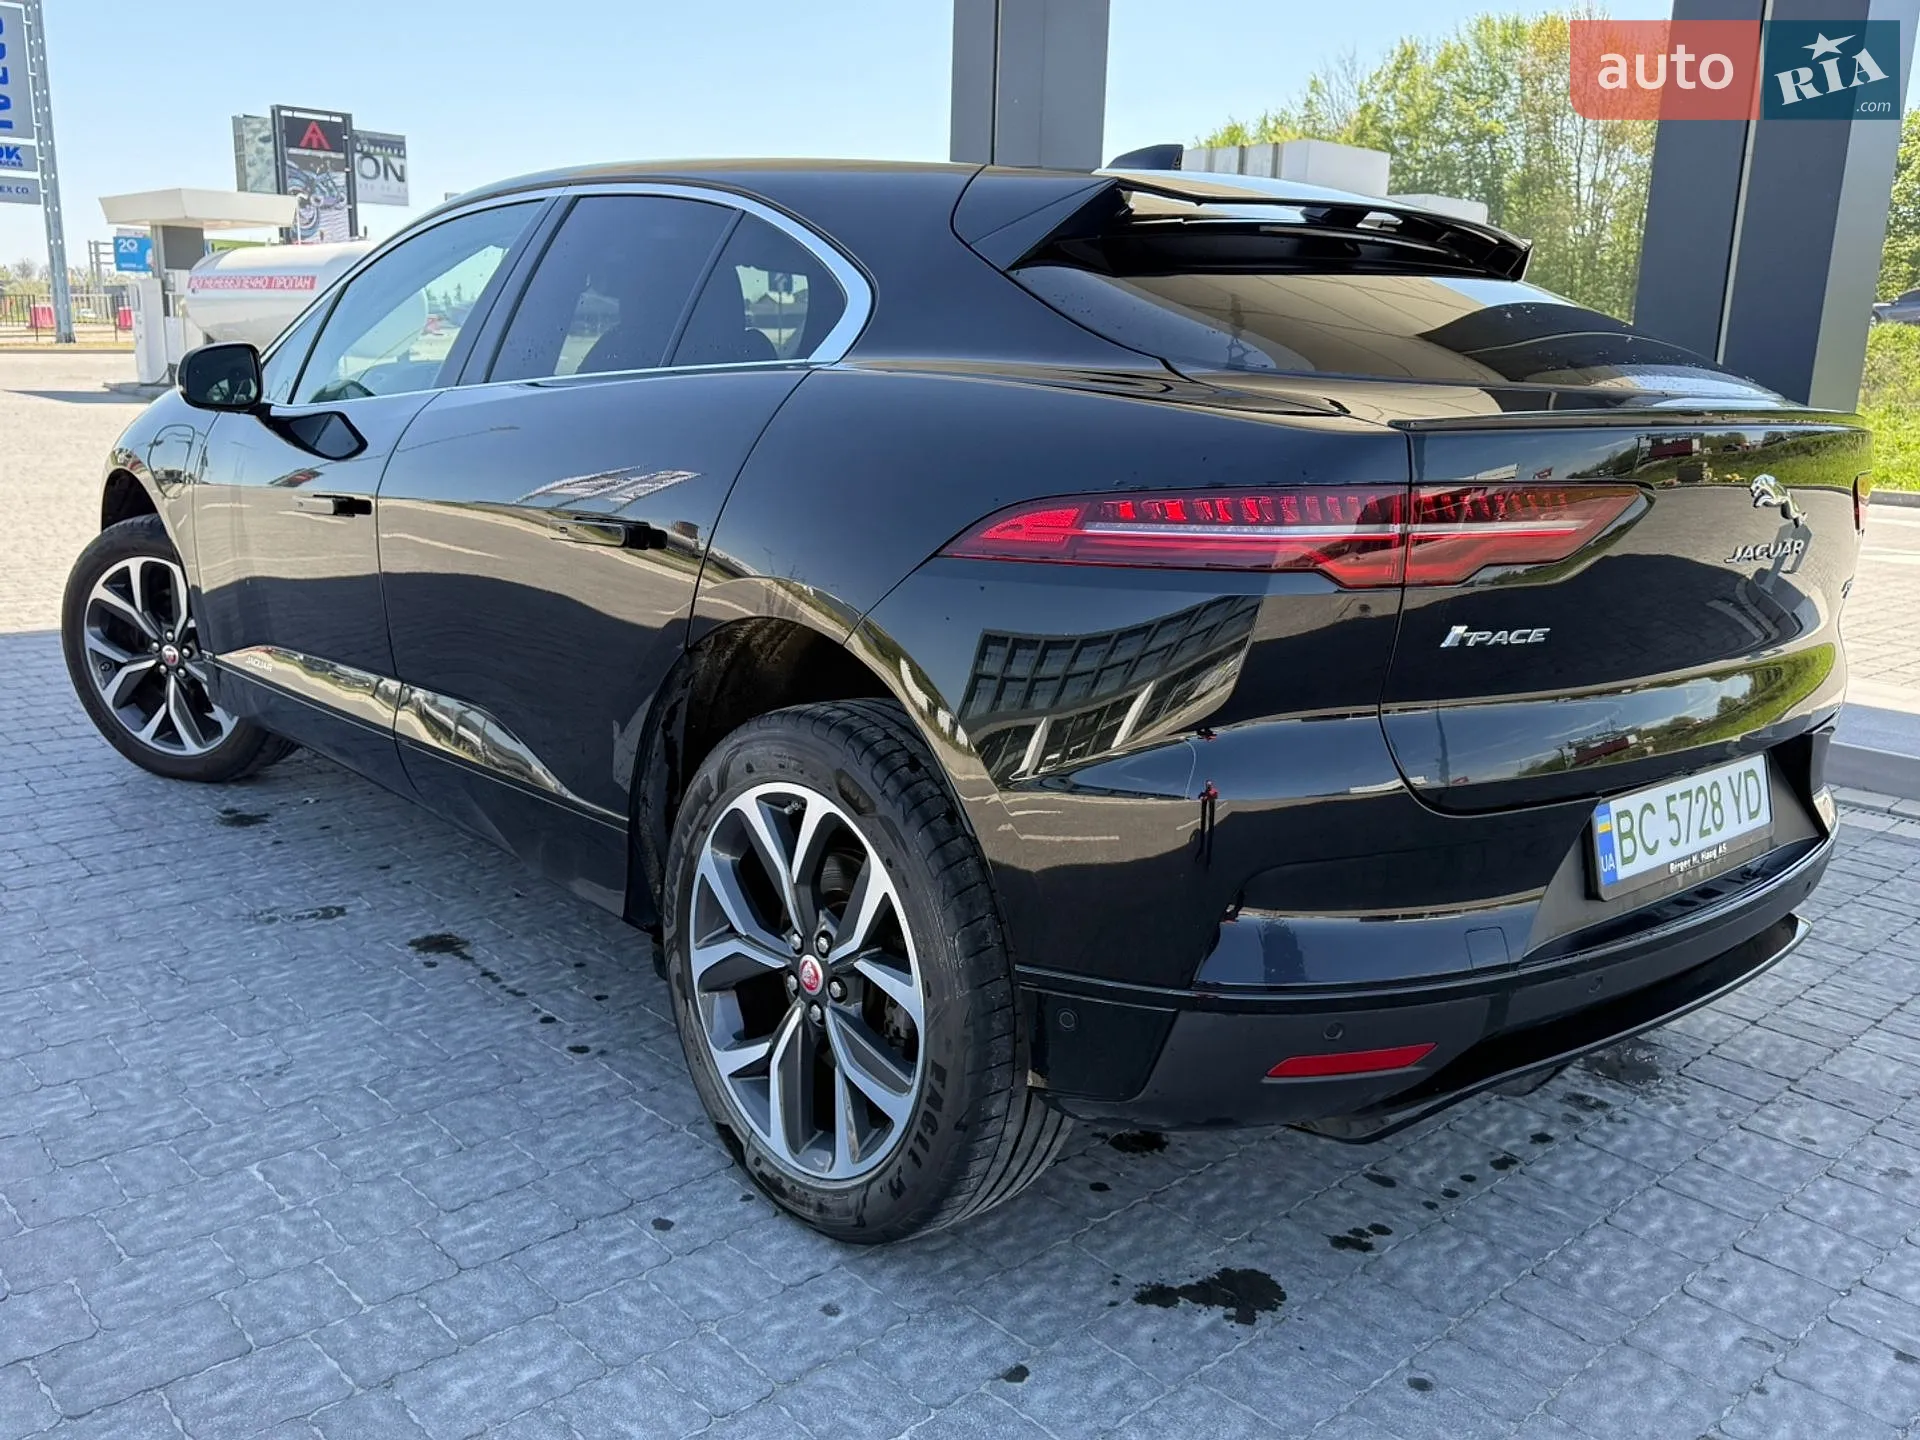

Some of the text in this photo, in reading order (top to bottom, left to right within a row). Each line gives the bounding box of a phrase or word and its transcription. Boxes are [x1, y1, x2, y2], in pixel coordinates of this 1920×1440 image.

[271, 275, 313, 289] ПРОПАН
[1724, 539, 1805, 563] JAGUAR
[1616, 768, 1762, 866] BC 5728 YD
[1601, 854, 1616, 873] UA
